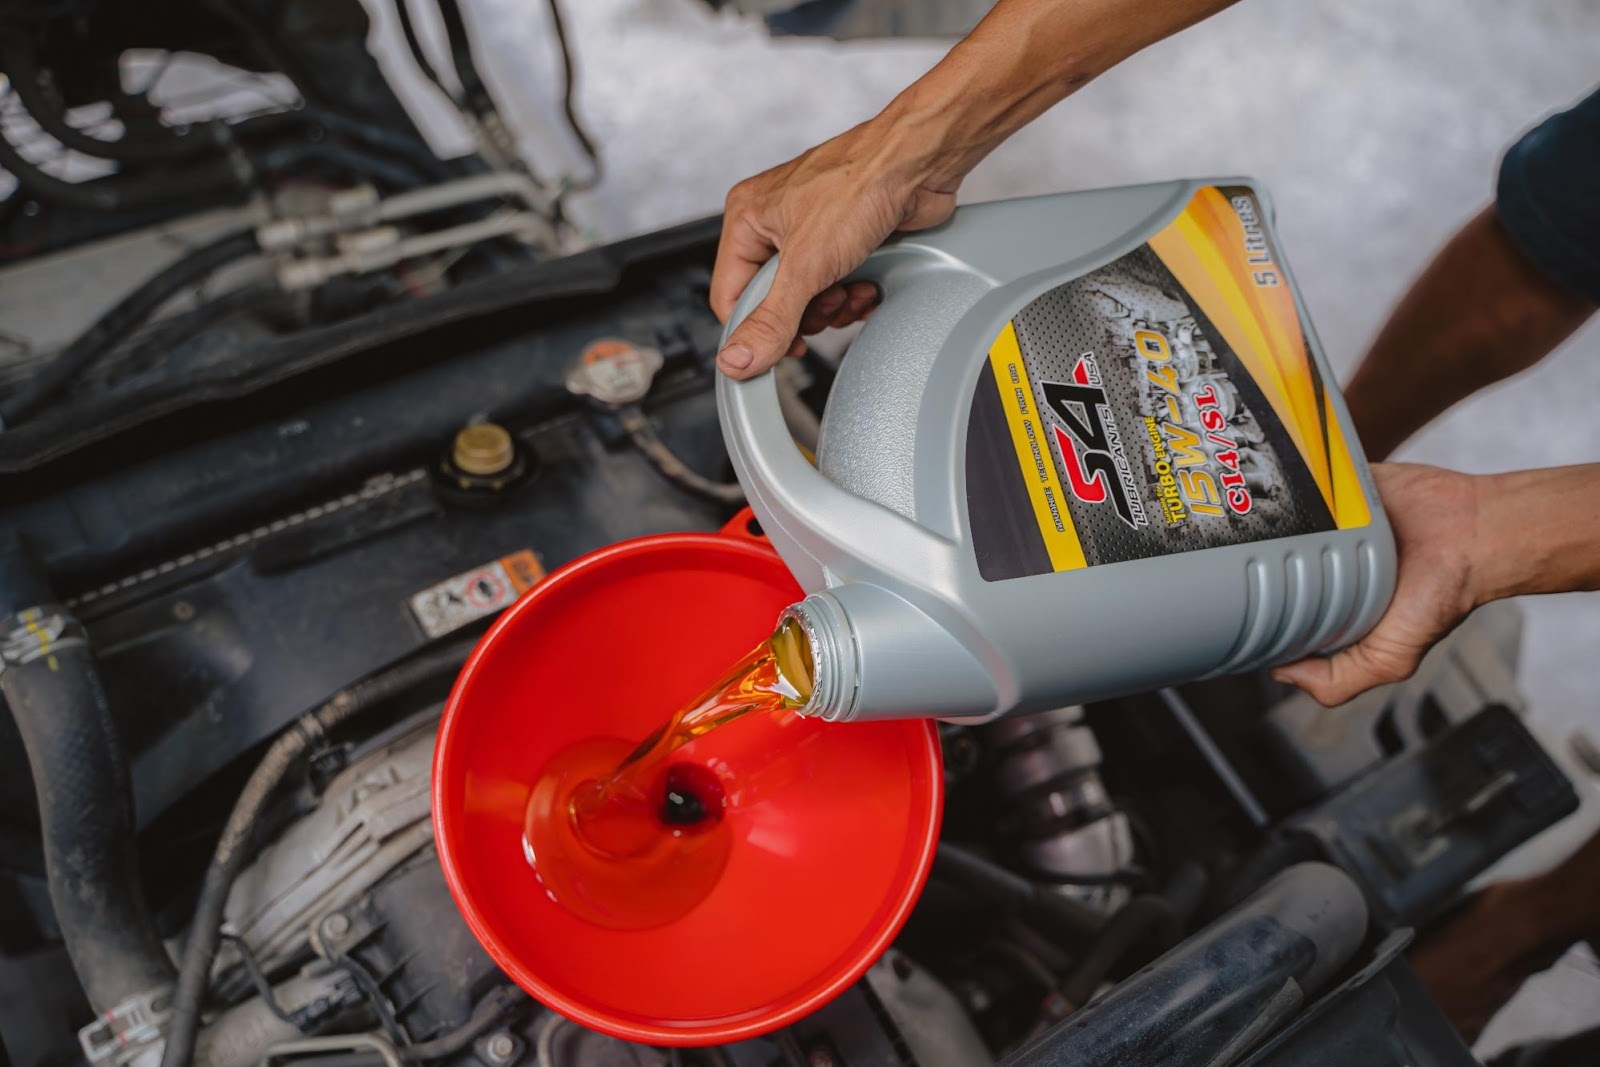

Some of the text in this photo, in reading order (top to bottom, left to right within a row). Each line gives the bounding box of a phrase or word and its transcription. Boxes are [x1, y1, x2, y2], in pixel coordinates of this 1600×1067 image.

[1231, 196, 1278, 287] 5 Litres
[1083, 351, 1103, 386] USA
[1134, 330, 1225, 517] 15W-40
[1007, 363, 1065, 532] ADVANCE TECHNOLOGY FROM USA
[1099, 403, 1148, 526] LUBRICANTS
[1144, 415, 1187, 524] TURBO ENGINE
